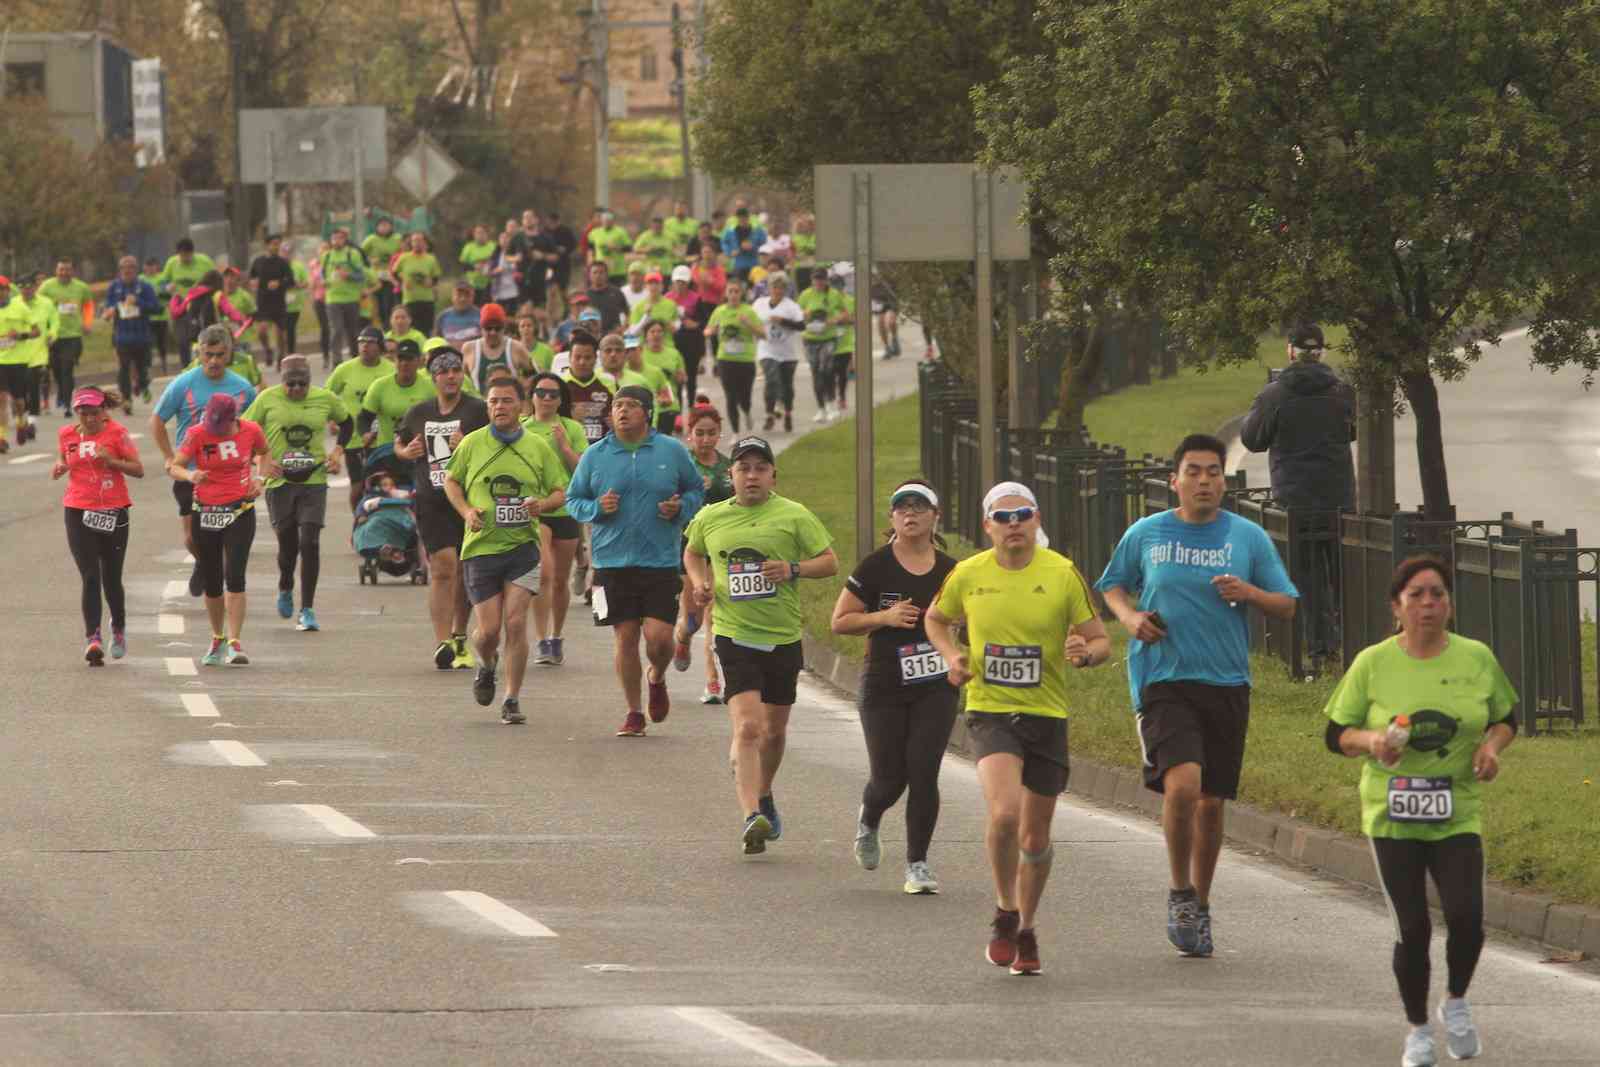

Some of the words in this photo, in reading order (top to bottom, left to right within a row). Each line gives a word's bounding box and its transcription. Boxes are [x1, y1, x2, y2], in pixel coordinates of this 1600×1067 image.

[203, 441, 240, 461] FR
[1151, 541, 1172, 567] got
[1176, 541, 1233, 568] braces?
[988, 659, 1035, 680] 4051
